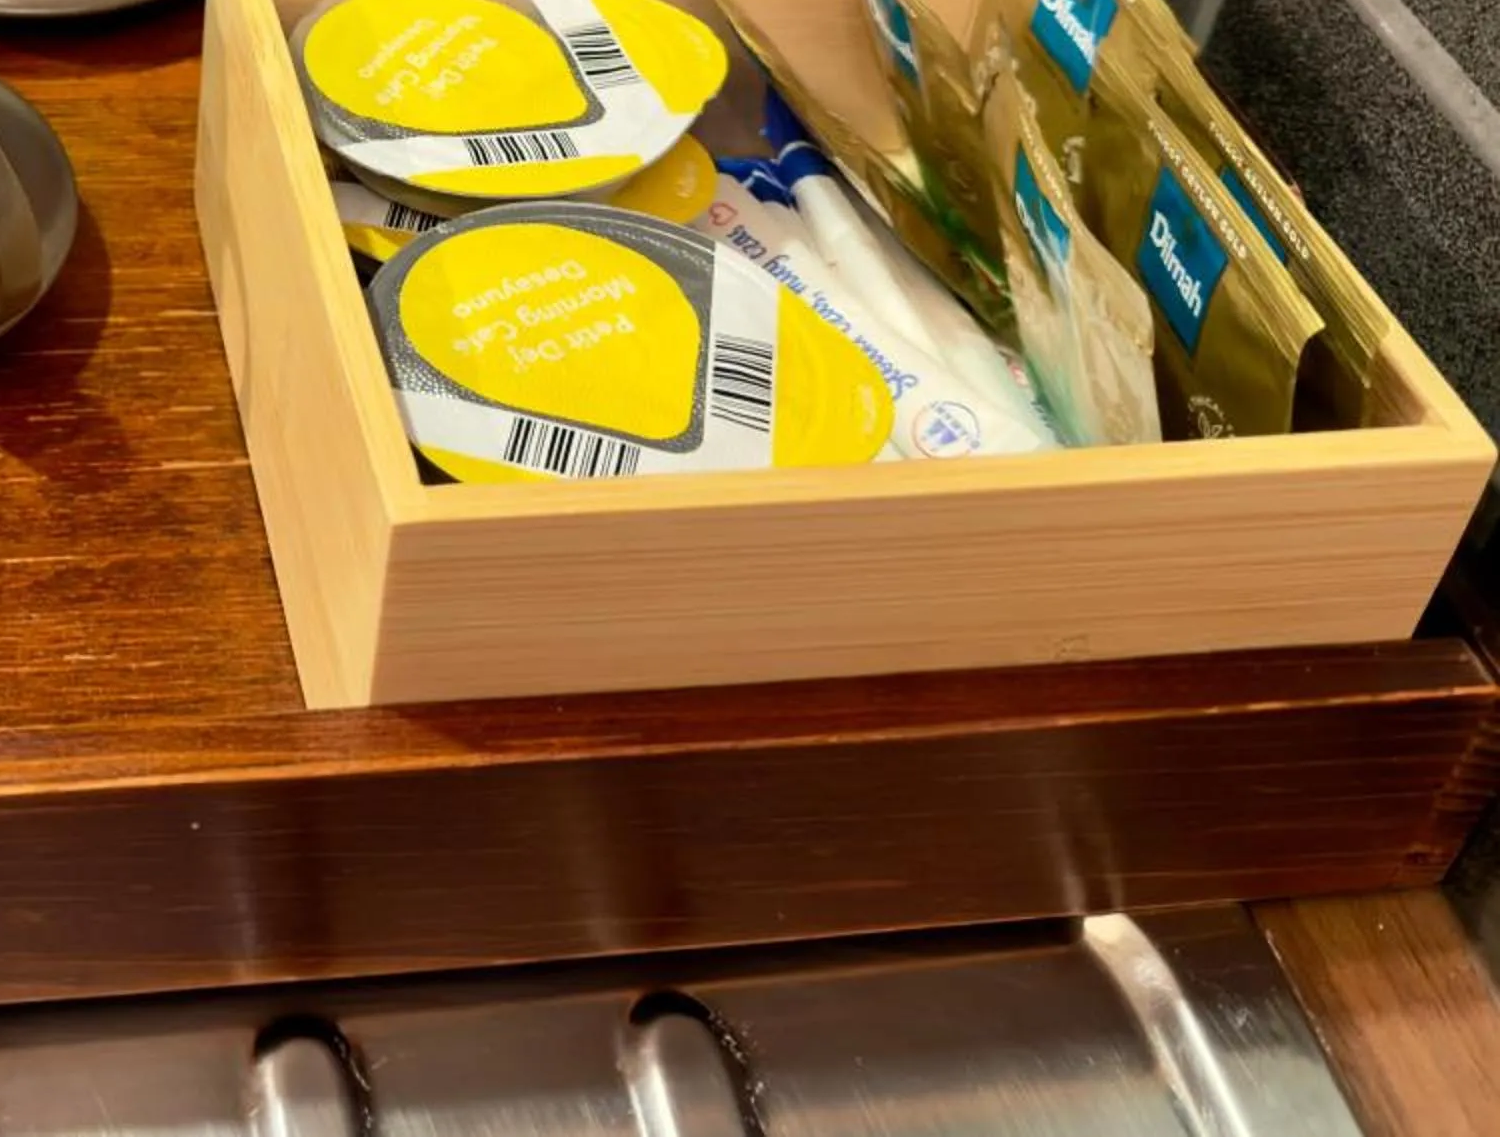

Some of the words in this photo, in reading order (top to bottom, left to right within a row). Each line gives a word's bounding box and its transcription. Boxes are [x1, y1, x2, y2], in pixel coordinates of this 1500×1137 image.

[451, 258, 587, 319] Desayuno
[1150, 210, 1201, 318] Dilmah
[515, 274, 637, 328] Morning
[563, 313, 636, 350] Petit
